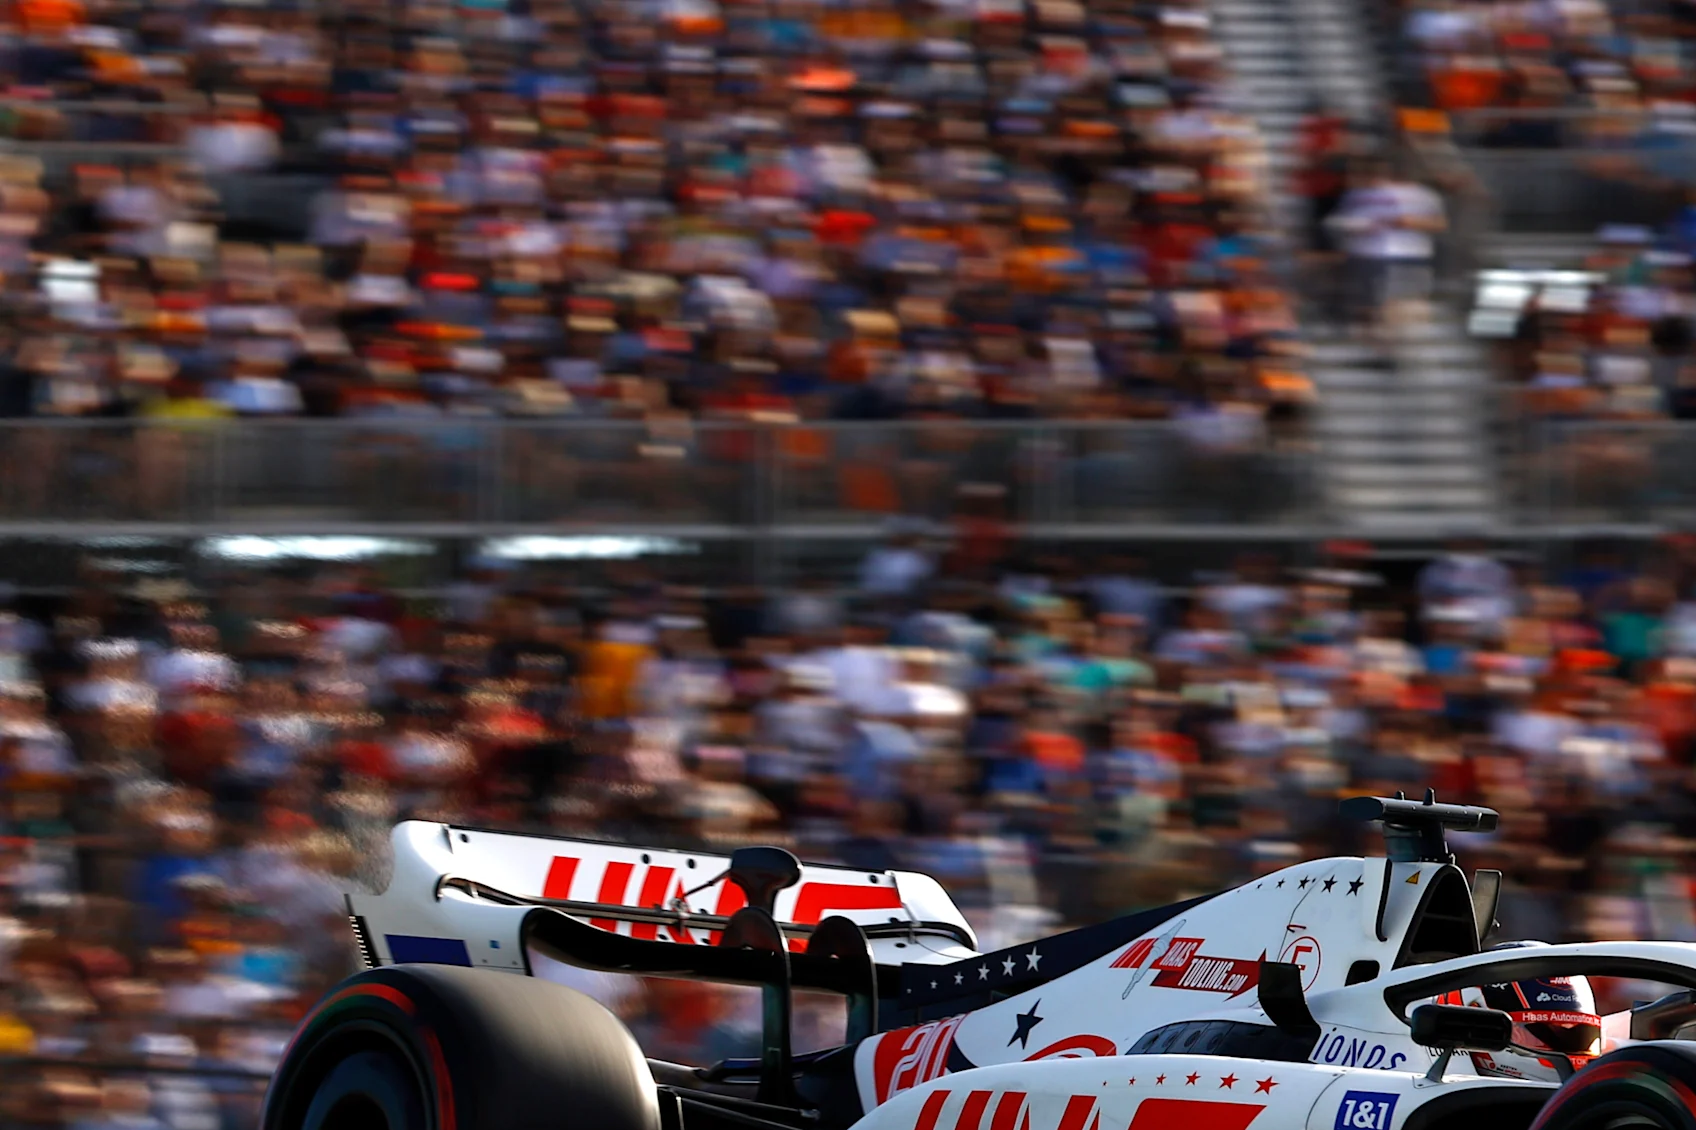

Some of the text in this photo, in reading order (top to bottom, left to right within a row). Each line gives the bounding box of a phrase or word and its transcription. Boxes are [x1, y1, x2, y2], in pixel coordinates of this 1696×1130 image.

[1159, 941, 1198, 968] HAAS
[1522, 1012, 1549, 1022] Haas
[1550, 1012, 1592, 1023] Automation
[1343, 1099, 1390, 1130] 1&1
